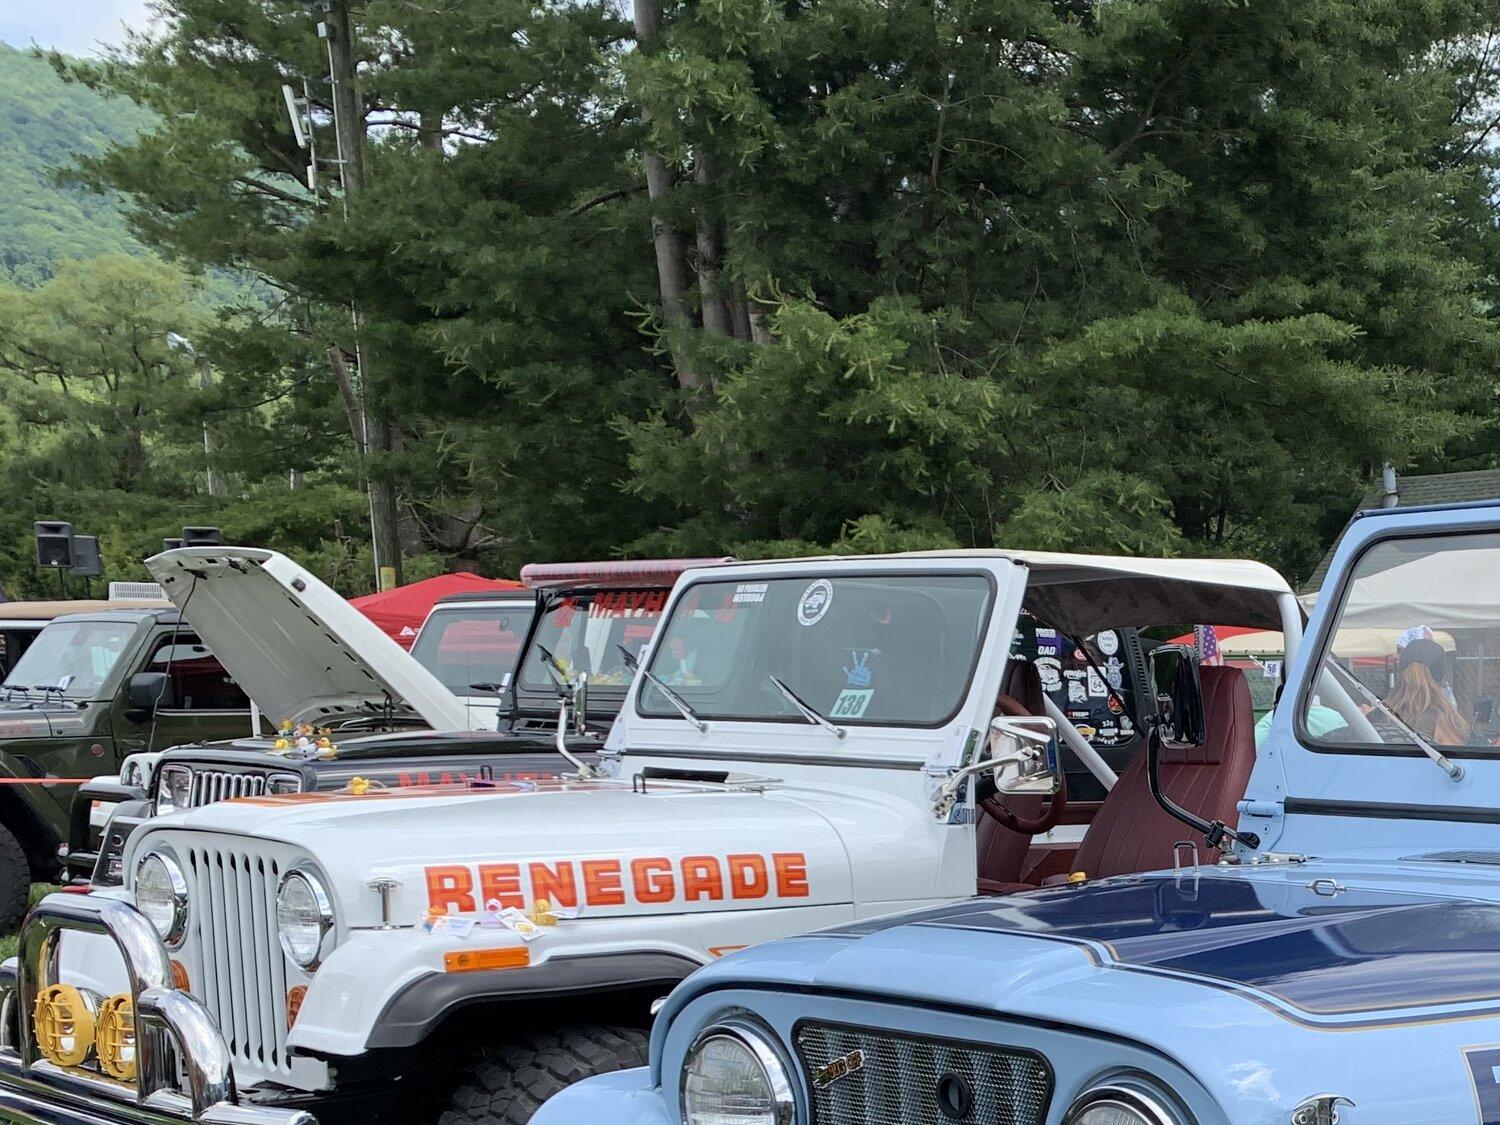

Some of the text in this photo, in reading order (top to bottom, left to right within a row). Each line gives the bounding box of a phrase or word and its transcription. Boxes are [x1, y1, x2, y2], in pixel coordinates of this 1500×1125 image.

[1037, 646, 1056, 656] DAD
[424, 852, 809, 912] RENEGADE
[828, 1050, 863, 1079] BUG OFF
